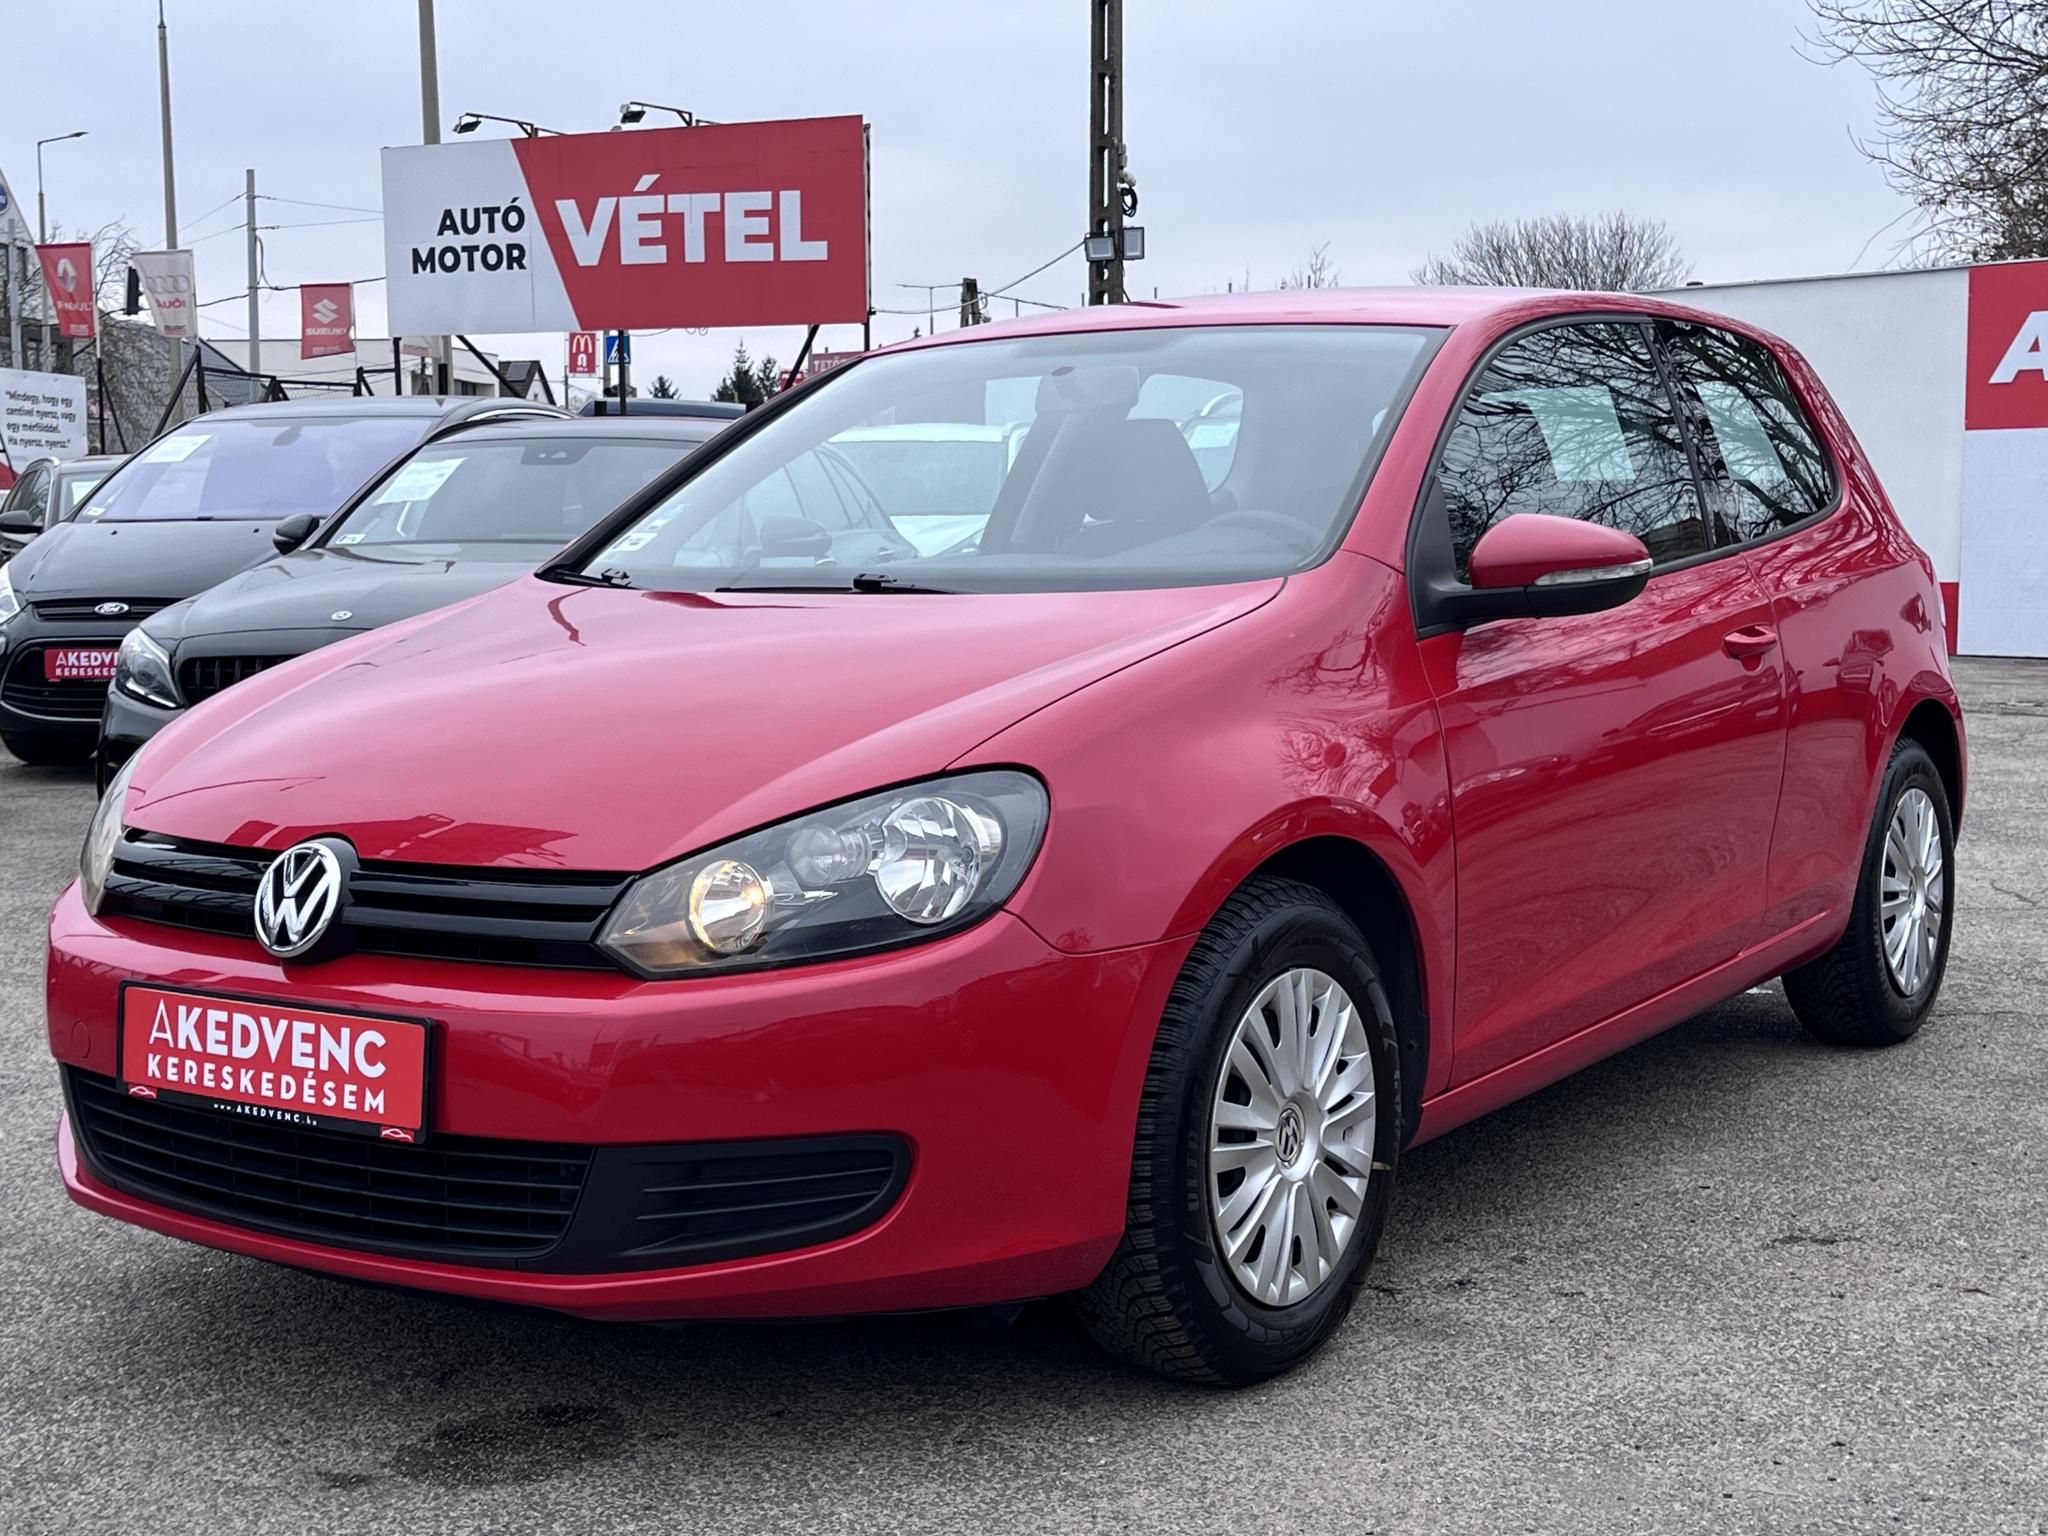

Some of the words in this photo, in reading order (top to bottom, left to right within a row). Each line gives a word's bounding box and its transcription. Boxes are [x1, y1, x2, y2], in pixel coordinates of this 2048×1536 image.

[436, 196, 526, 236] AUTÓ
[554, 173, 829, 267] VÉTEL
[411, 243, 527, 275] MOTOR
[149, 998, 387, 1079] AKEDVENC
[147, 1053, 385, 1114] KERESKEDÉSEM
